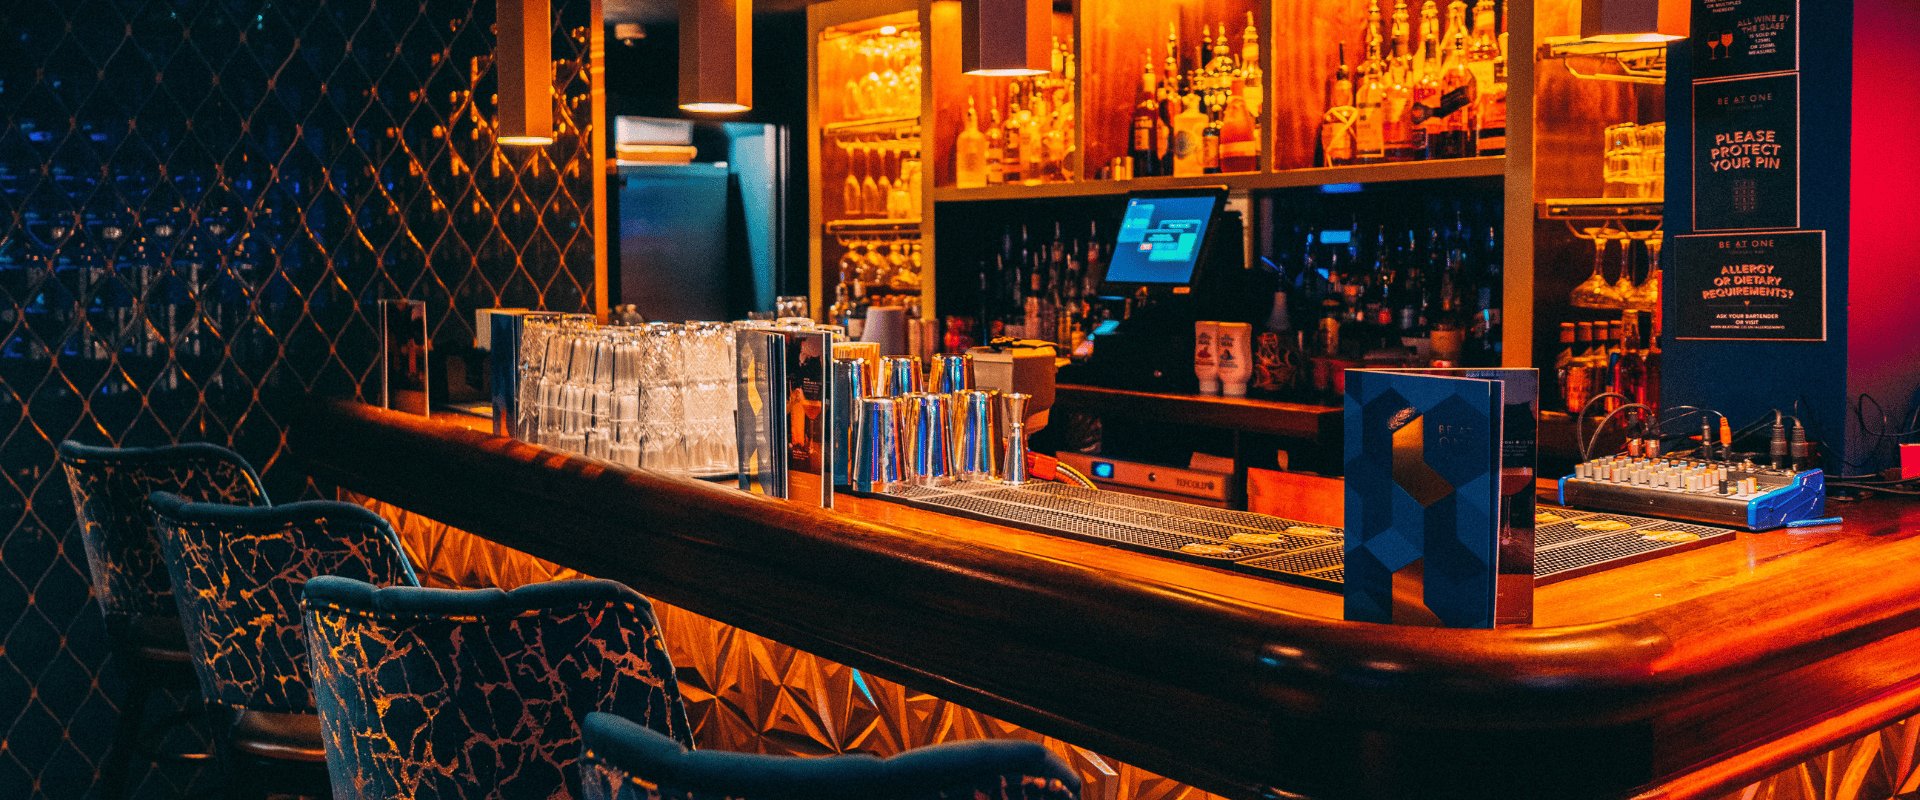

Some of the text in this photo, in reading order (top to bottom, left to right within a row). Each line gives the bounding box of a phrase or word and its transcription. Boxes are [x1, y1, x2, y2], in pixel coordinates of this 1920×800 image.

[1738, 18, 1752, 27] ALL
[1755, 15, 1776, 23] WINE
[1742, 25, 1757, 33] THE
[1718, 93, 1772, 105] BE AT ONE
[1716, 131, 1775, 145] PLEASE
[1711, 144, 1781, 159] PROTECT
[1711, 157, 1780, 172] YOUR PIN
[1719, 241, 1730, 249] BE
[1721, 264, 1774, 275] ALLERGY
[1714, 275, 1782, 287] OR DIETARY
[1702, 286, 1794, 300] REQUIREMENTS?
